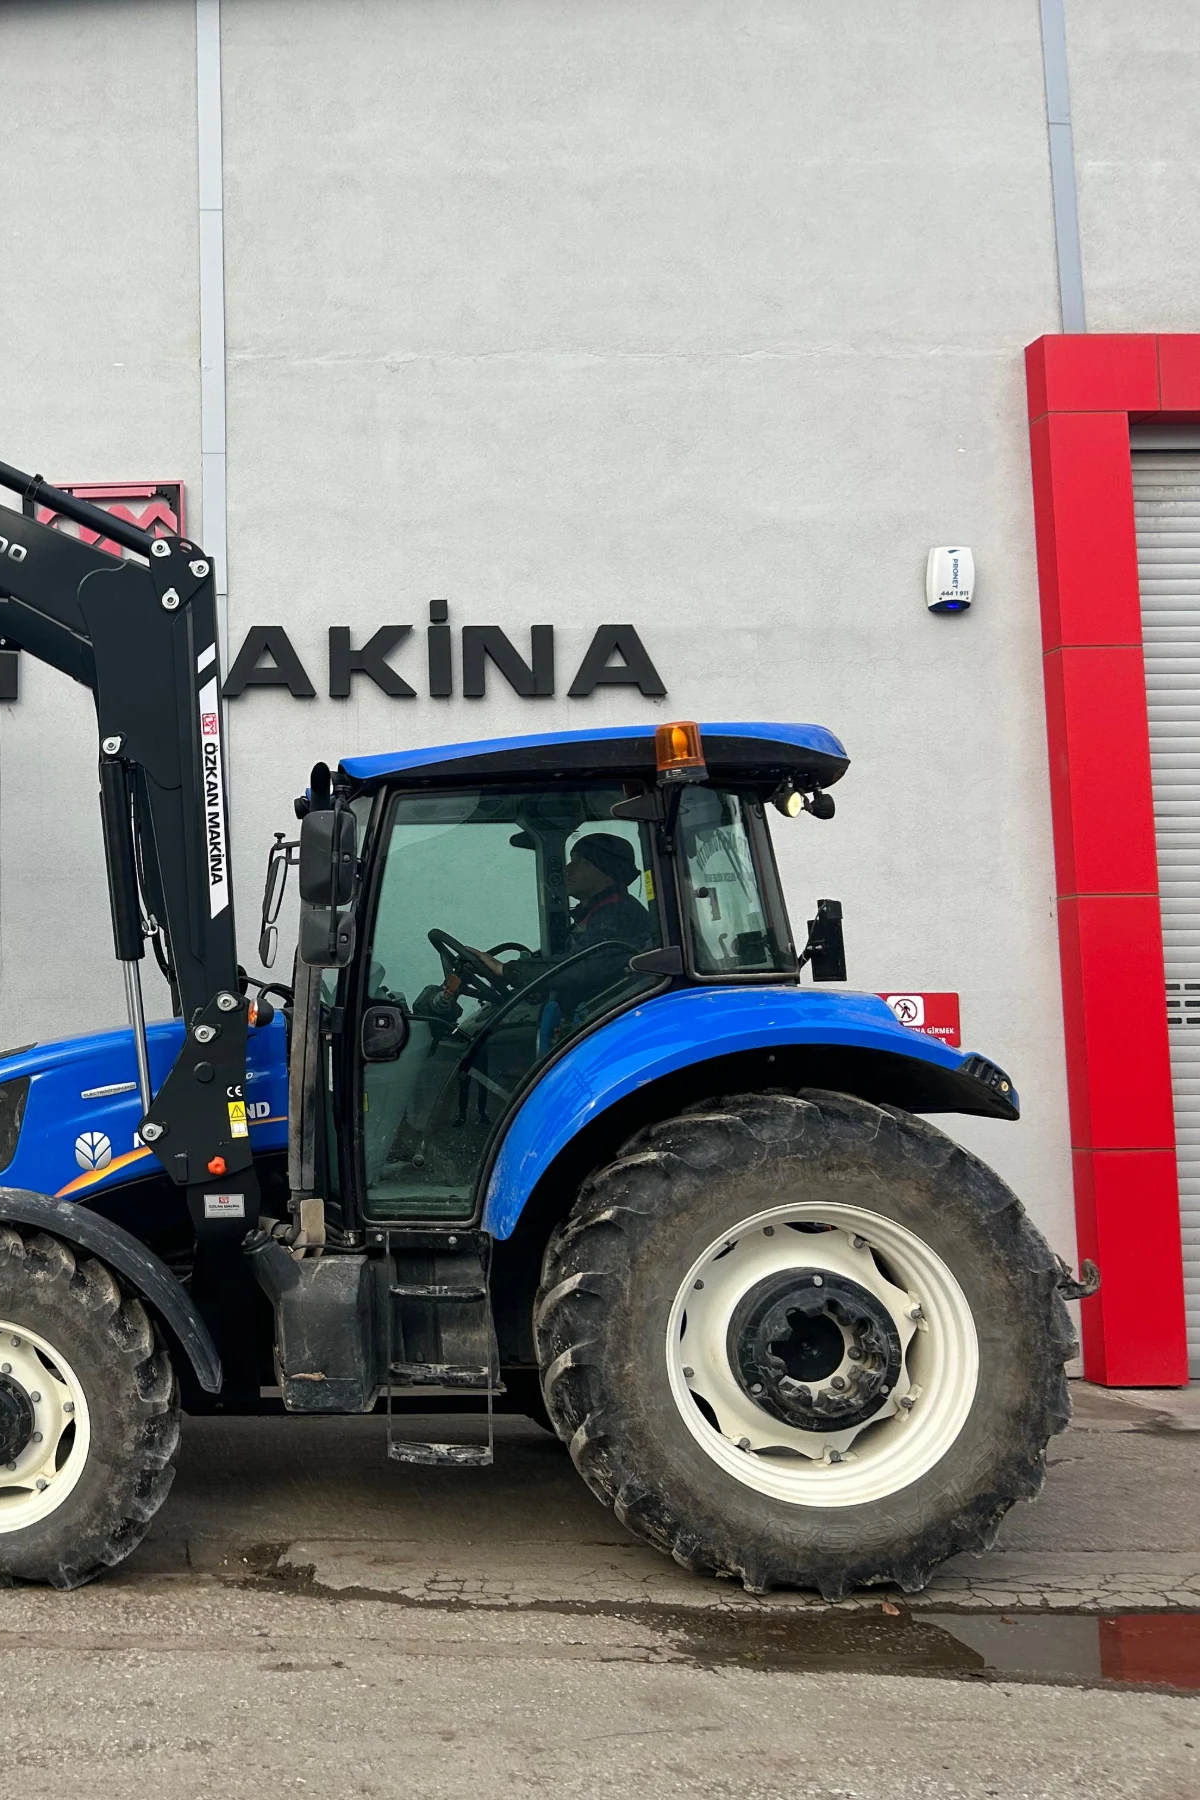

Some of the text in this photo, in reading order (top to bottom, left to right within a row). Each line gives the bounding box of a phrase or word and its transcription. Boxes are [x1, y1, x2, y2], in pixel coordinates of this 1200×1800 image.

[221, 598, 668, 698] AKİNA
[203, 742, 219, 807] ÖZKAN
[207, 811, 224, 886] MAKİNA
[926, 1026, 955, 1034] GİRMEK
[226, 1085, 243, 1098] CE
